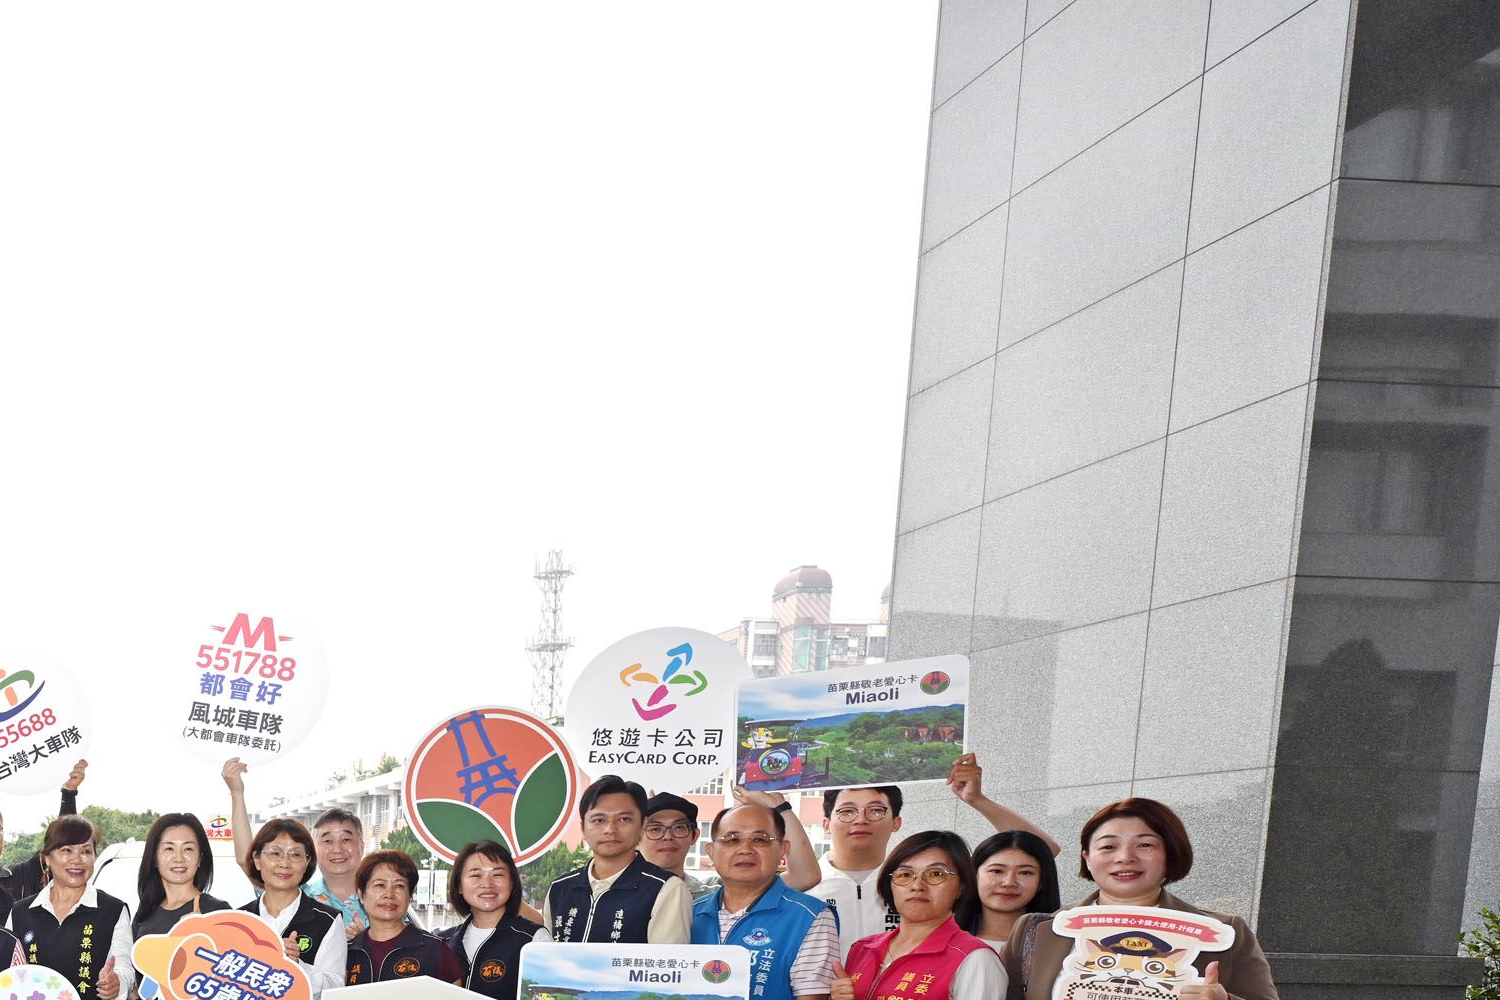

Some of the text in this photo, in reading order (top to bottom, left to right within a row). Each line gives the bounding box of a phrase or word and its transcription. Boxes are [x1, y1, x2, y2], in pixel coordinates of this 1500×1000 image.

[196, 644, 296, 681] 551788
[200, 672, 283, 705] 都會好
[827, 674, 919, 693] 苗栗縣敬老愛心卡
[845, 688, 899, 705] Miaoli
[187, 701, 283, 735] 風城車隊
[182, 726, 281, 753] (大都會車隊委託)
[591, 728, 723, 748] 悠遊卡公司
[610, 908, 624, 943] 造橋鄉
[1125, 939, 1149, 948] TAXI
[77, 924, 93, 993] 苗栗縣議會
[611, 957, 700, 969] 苗栗縣敬老愛心卡
[628, 969, 682, 984] Miaoli
[753, 948, 775, 996] 立法委員
[914, 973, 936, 995] 立委
[1113, 986, 1134, 995] 本車
